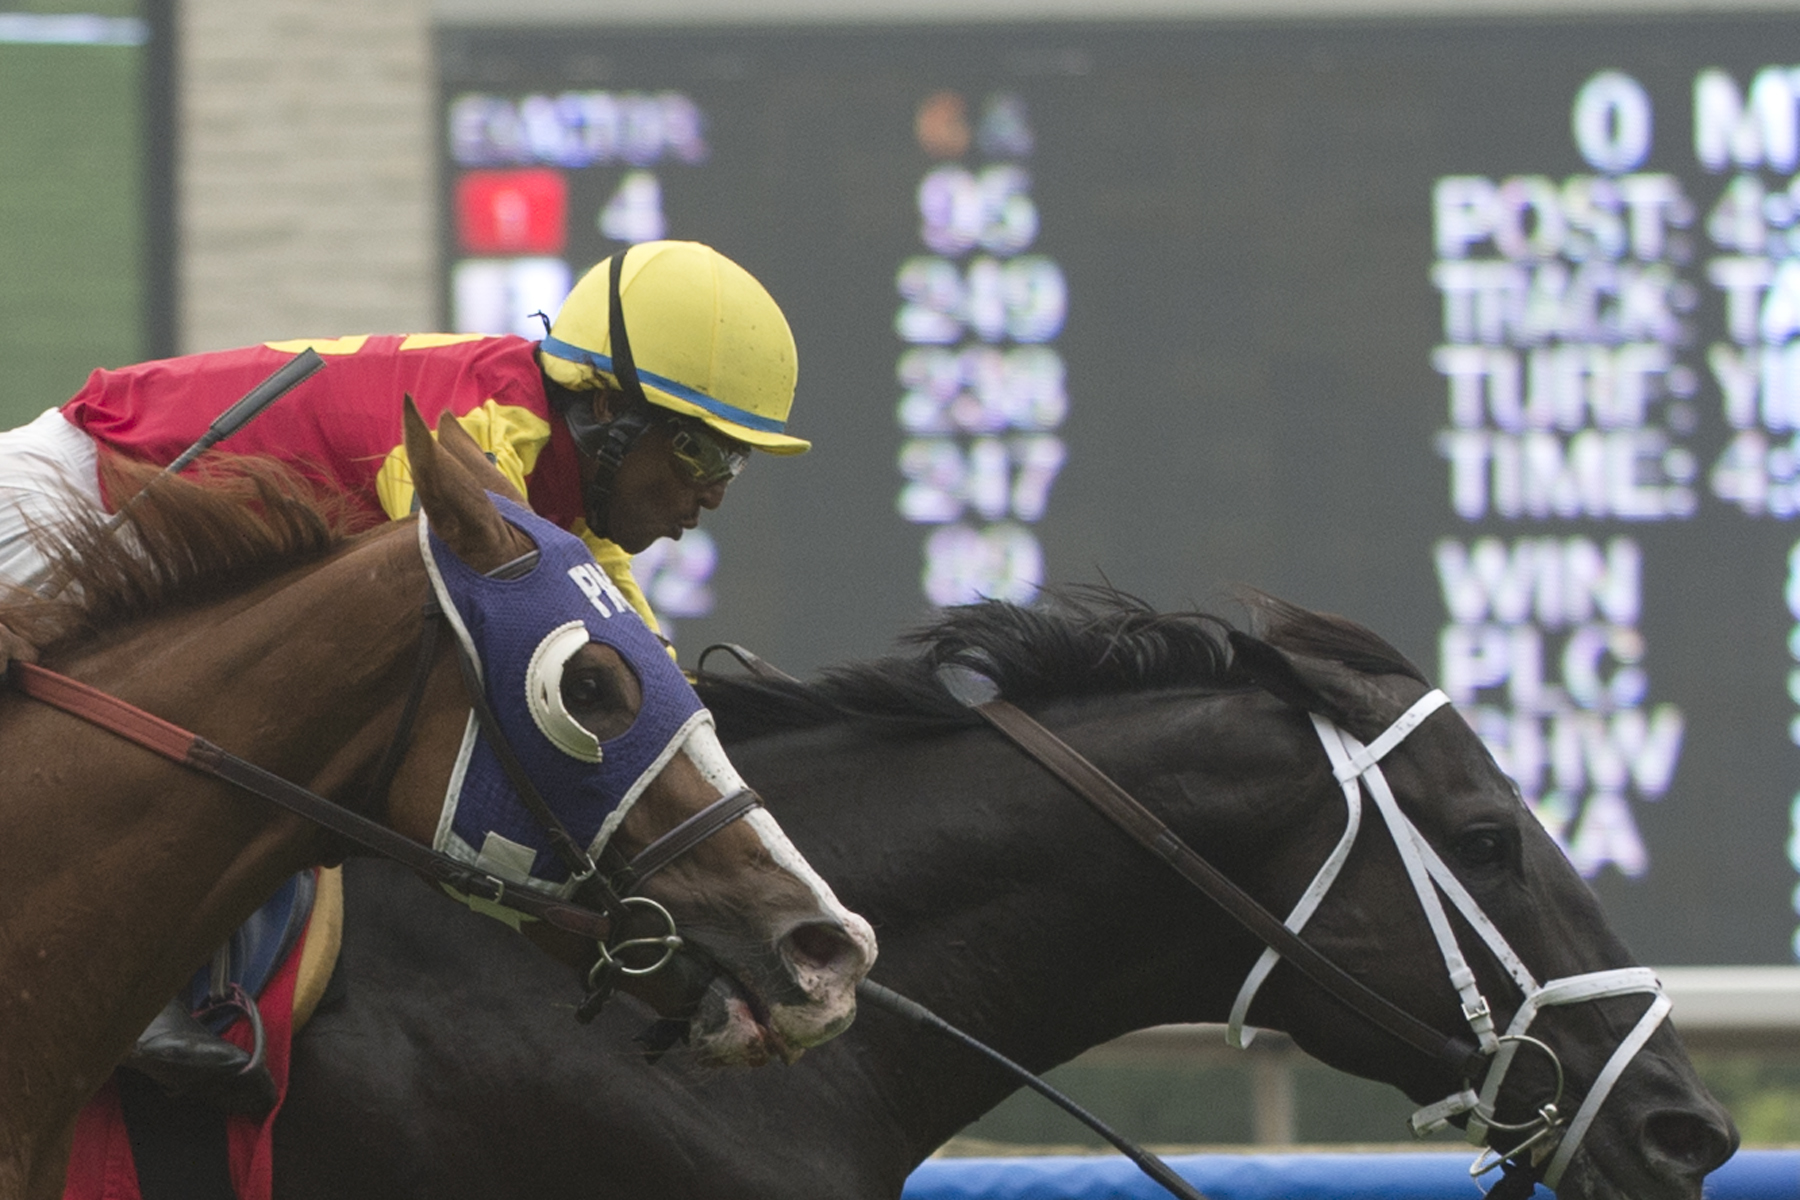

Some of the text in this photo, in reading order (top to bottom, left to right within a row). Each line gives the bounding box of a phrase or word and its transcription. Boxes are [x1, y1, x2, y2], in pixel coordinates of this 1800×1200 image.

[1691, 64, 1800, 174] M
[1431, 172, 1800, 264] POST: 4:
[1709, 430, 1800, 520] 4:
[1436, 534, 1644, 628] WIN
